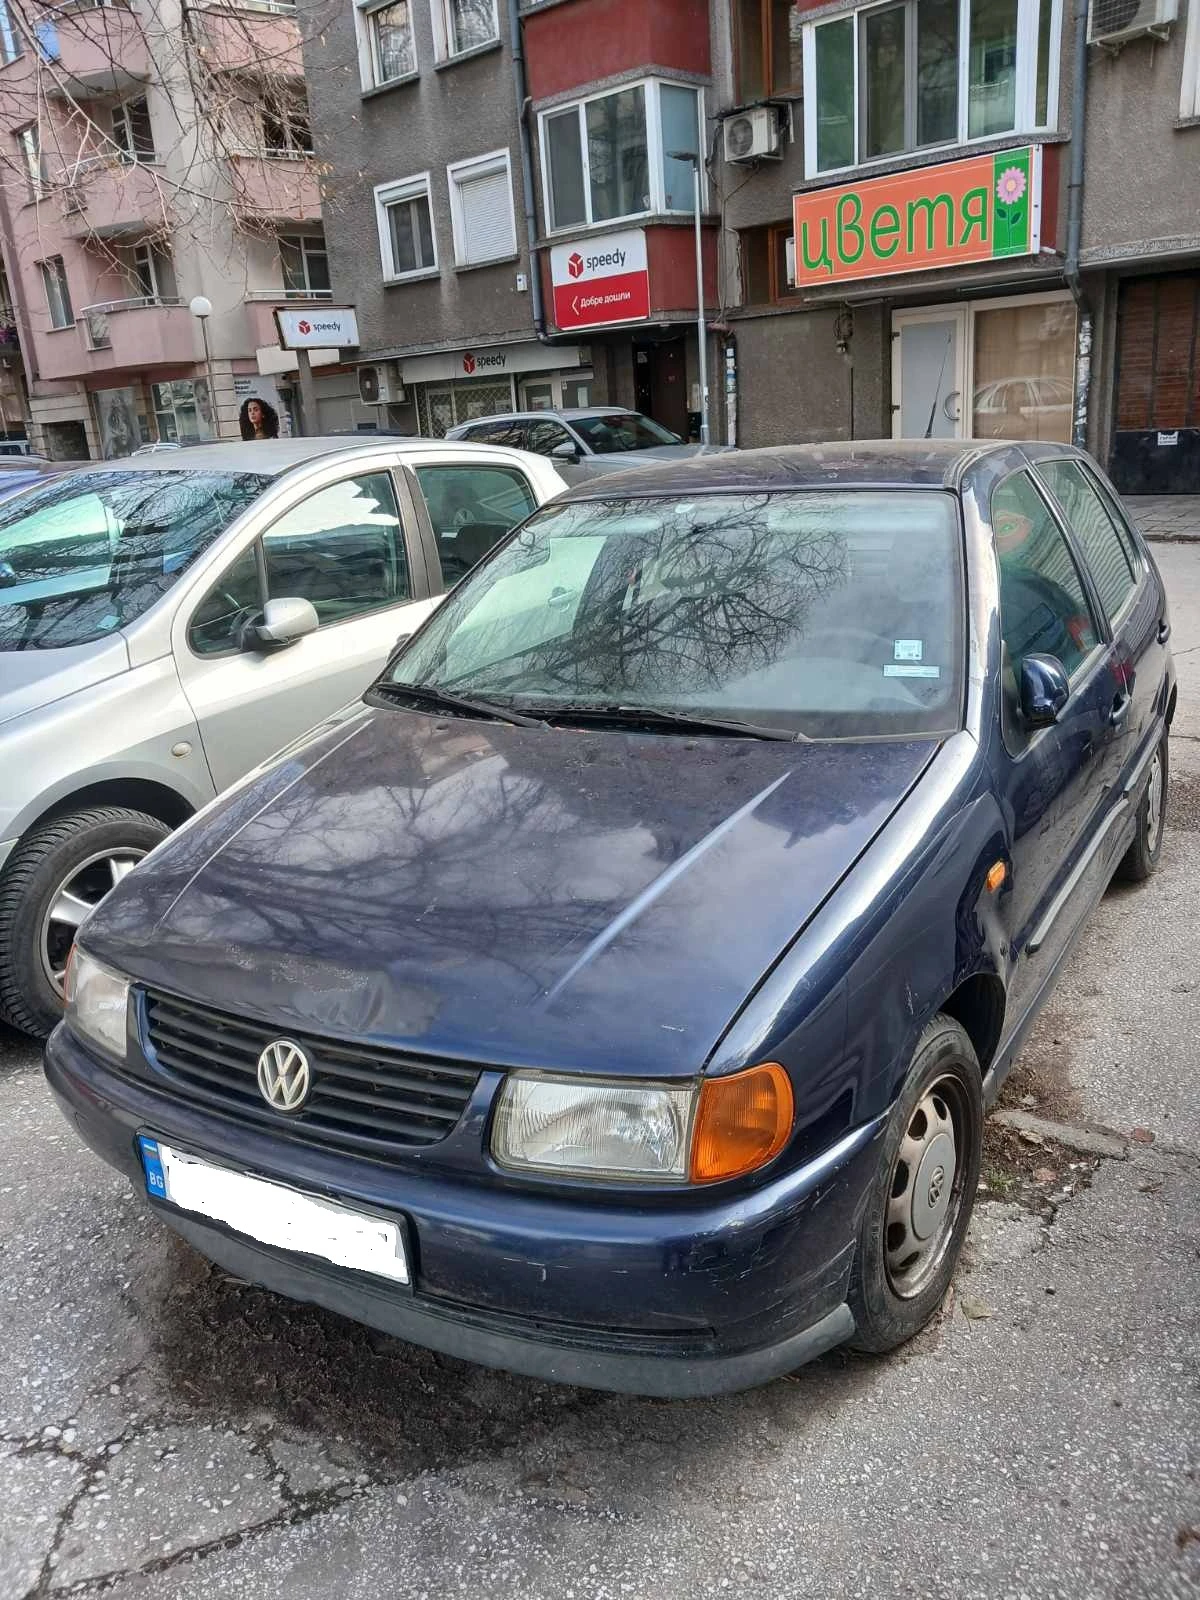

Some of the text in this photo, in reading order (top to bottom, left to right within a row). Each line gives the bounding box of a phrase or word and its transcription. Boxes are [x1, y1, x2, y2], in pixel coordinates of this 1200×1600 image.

[802, 187, 987, 275] цветя
[586, 248, 626, 272] speedy
[580, 296, 603, 308] Добре
[313, 321, 341, 333] speedy
[477, 352, 506, 369] speedy
[149, 1171, 164, 1189] BG
